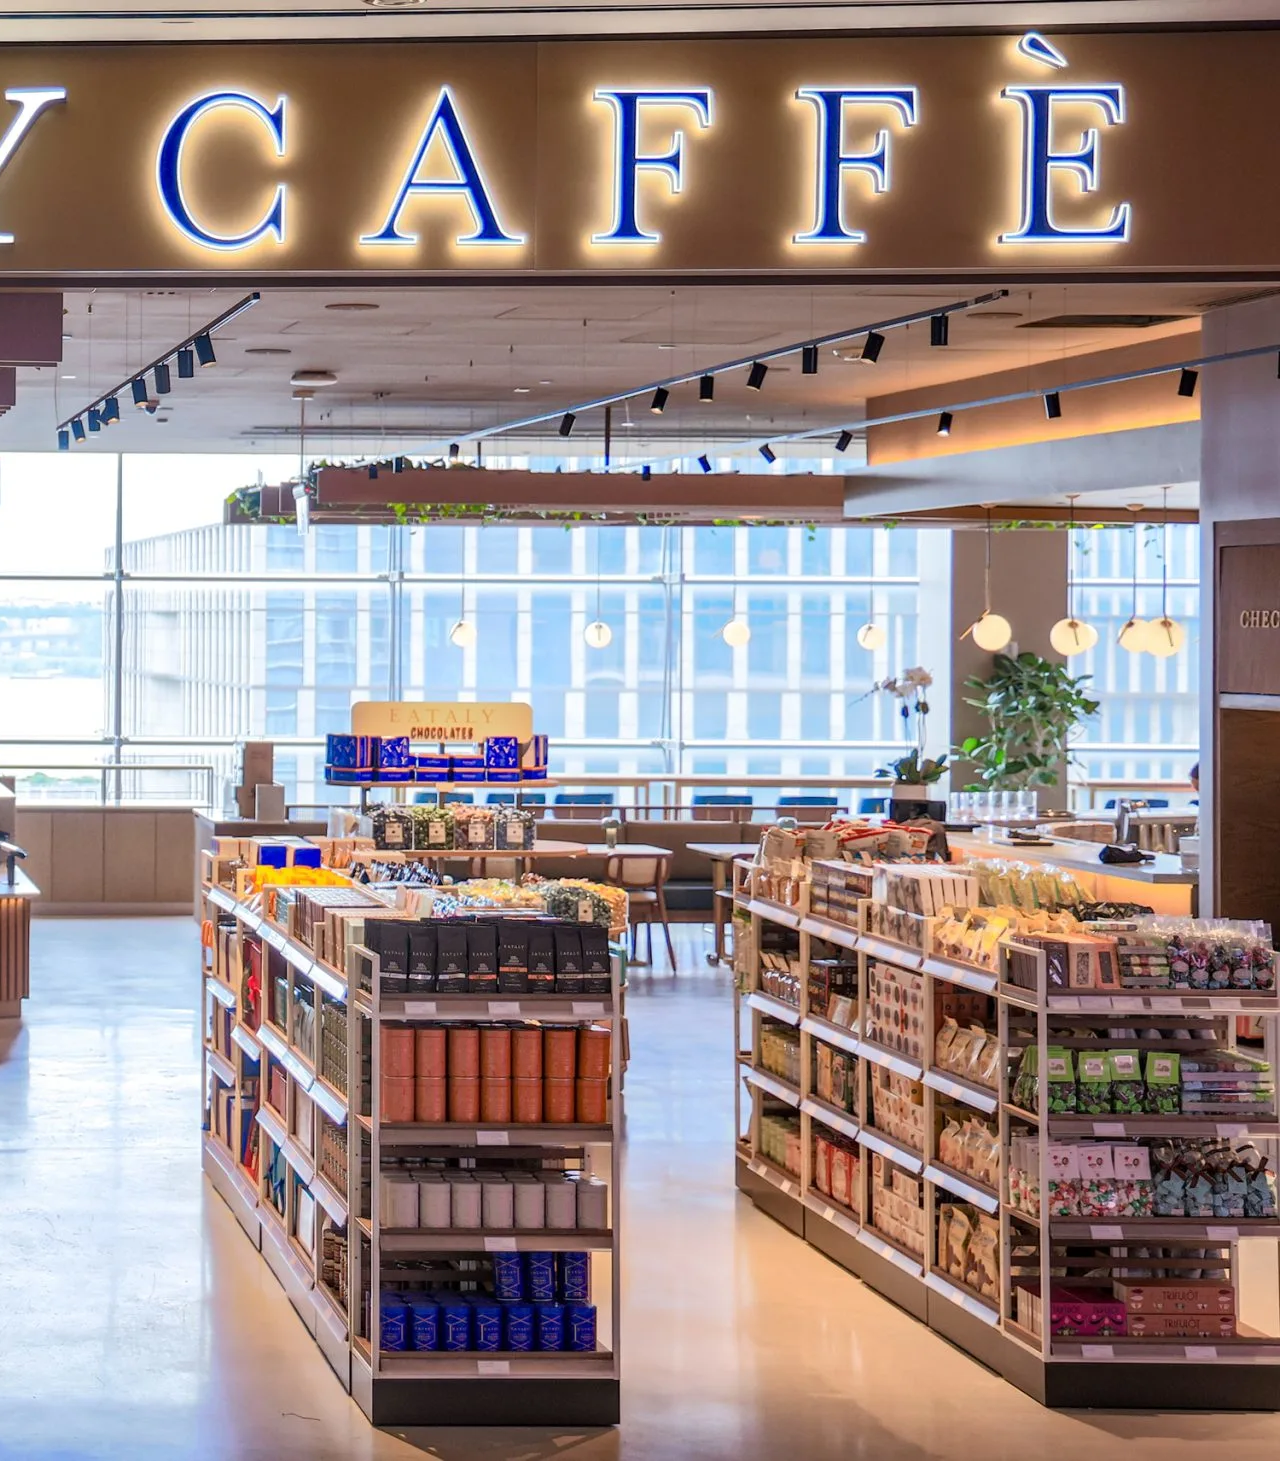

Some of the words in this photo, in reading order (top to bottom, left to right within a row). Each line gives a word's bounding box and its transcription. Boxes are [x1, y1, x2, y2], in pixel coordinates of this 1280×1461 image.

[155, 32, 1130, 251] CAFFÈ
[389, 708, 497, 724] EATALY
[410, 727, 474, 740] CHOCOLATES
